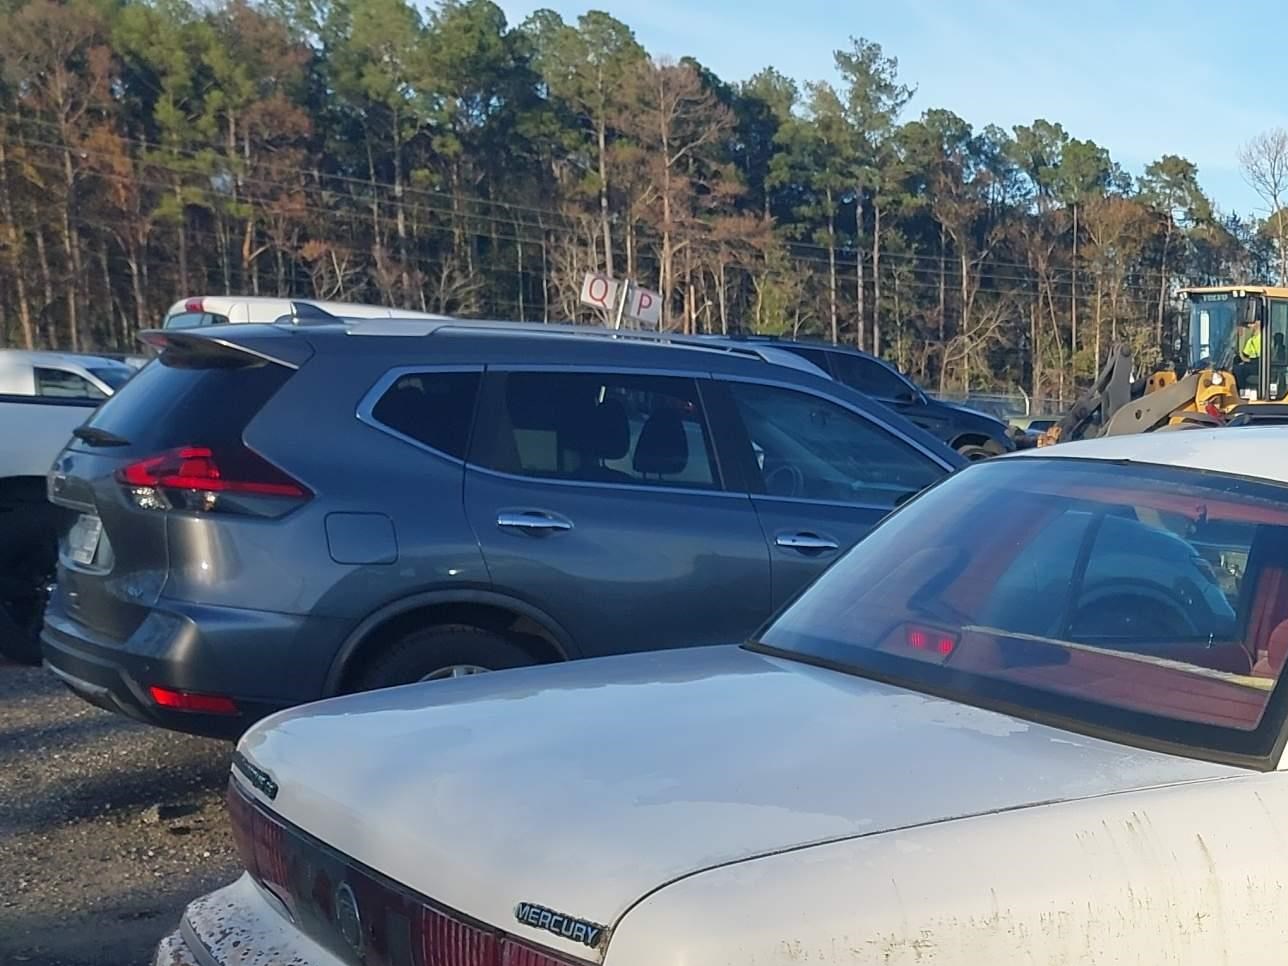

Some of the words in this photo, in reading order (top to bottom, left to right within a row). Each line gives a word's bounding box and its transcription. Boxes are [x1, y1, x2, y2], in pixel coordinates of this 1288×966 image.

[589, 276, 609, 308] Q
[637, 292, 653, 316] P
[518, 903, 599, 944] MERCURY
